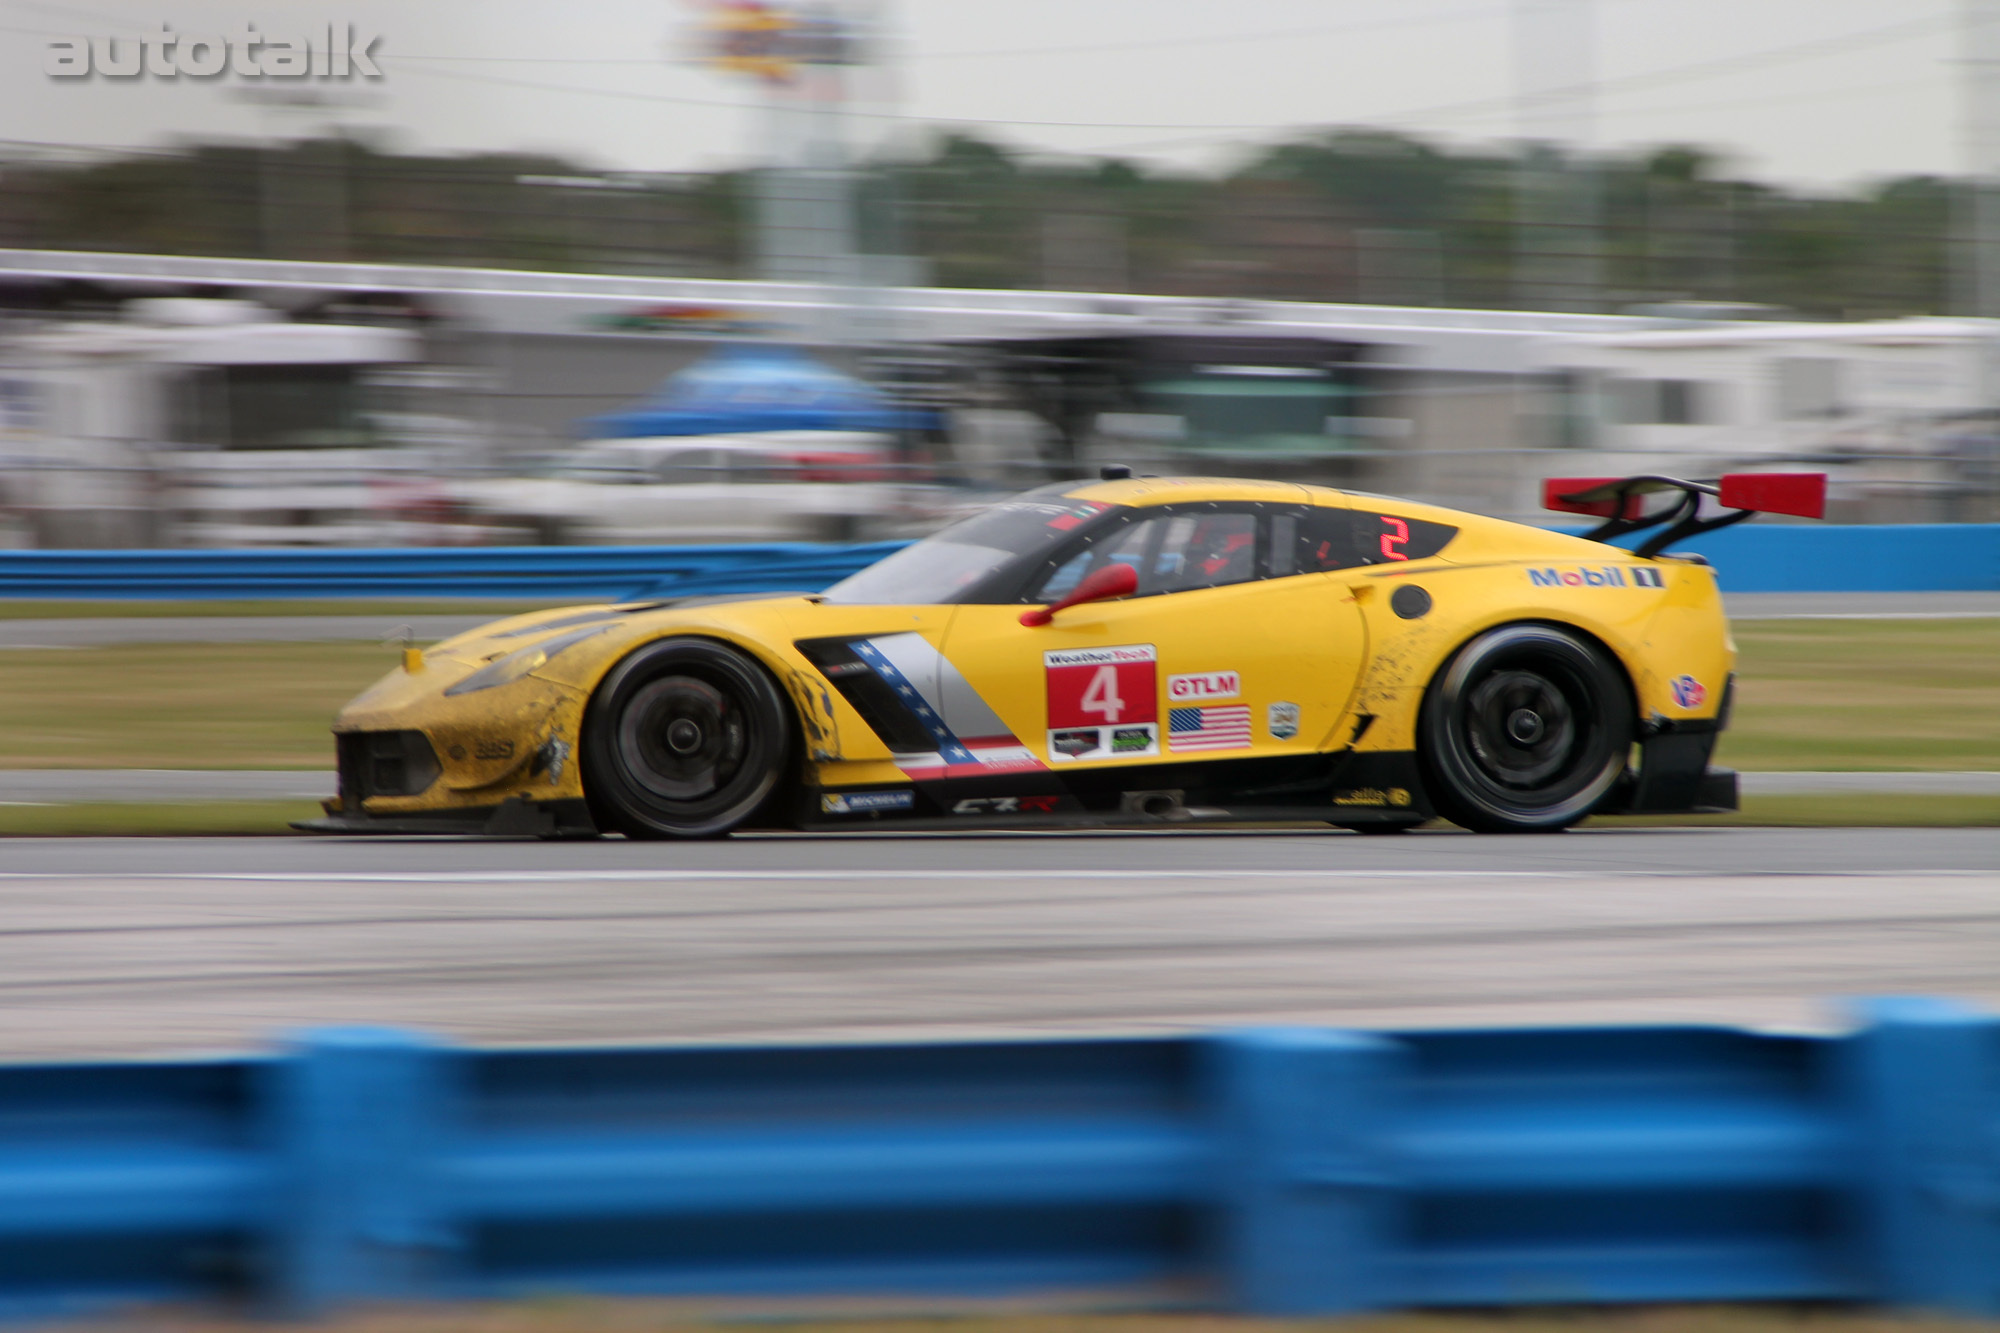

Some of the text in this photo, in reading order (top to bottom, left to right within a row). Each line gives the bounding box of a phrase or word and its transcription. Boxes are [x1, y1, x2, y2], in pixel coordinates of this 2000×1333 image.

[1380, 516, 1409, 561] 2
[1527, 566, 1627, 588] Mobil
[1080, 665, 1126, 722] 4
[1171, 675, 1237, 696] GTLM
